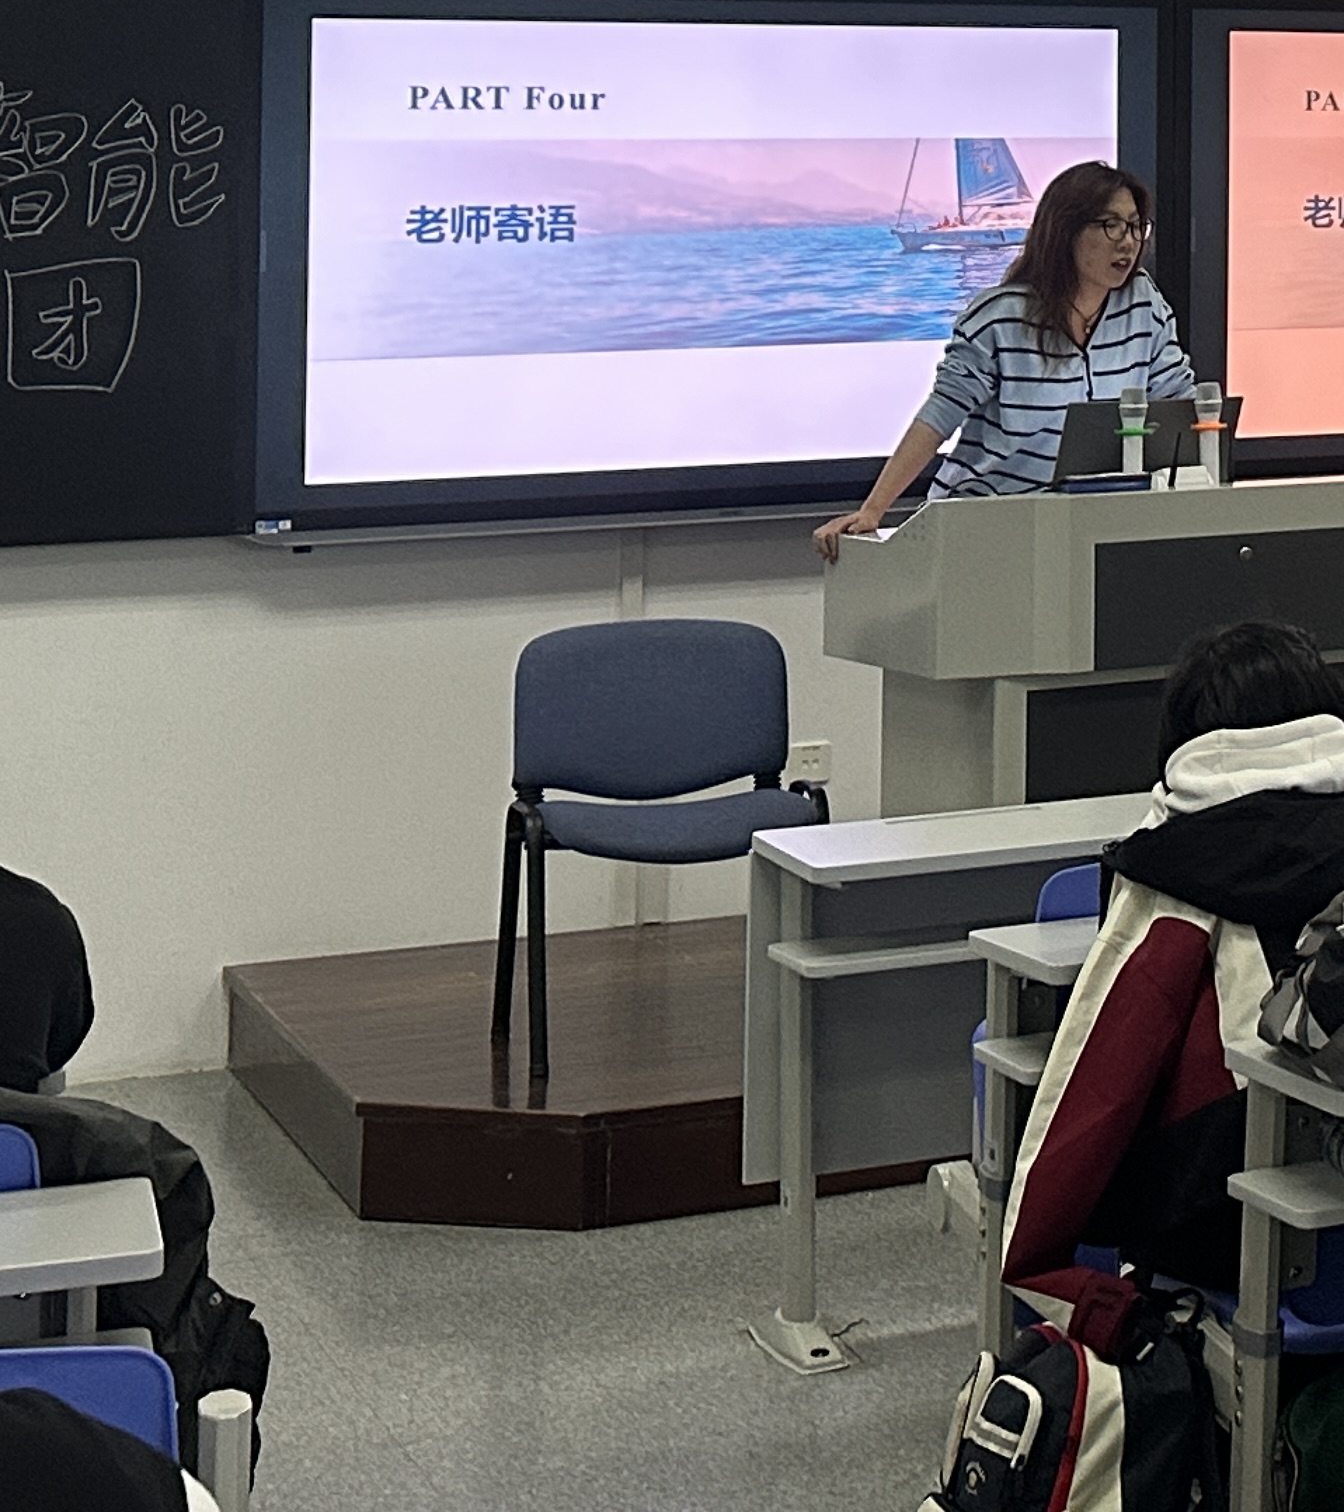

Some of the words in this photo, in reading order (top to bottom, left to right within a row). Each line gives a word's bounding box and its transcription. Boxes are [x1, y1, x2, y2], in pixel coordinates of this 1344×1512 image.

[408, 85, 511, 112] PART
[523, 86, 608, 112] Four
[404, 203, 578, 244] 老师寄语
[3, 256, 142, 393] 团
